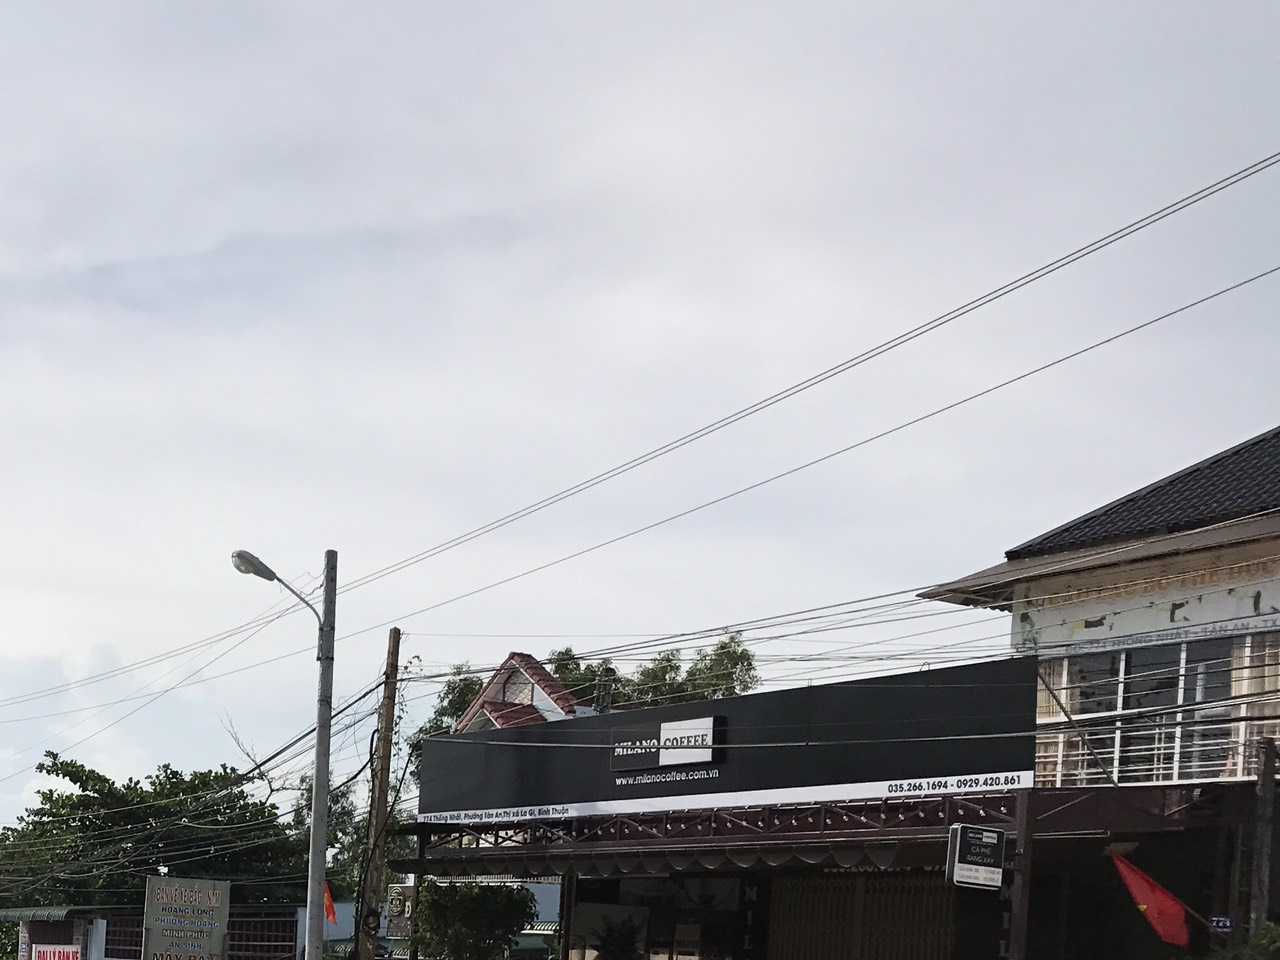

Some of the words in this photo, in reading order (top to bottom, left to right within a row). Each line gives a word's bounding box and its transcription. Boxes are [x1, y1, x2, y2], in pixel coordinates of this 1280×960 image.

[614, 739, 658, 756] MILANO
[664, 733, 708, 750] COFFEE
[615, 769, 719, 786] www.milanocoffee.com.vn
[887, 781, 948, 794] 035.266.1694
[956, 775, 1021, 789] 0929.420.861
